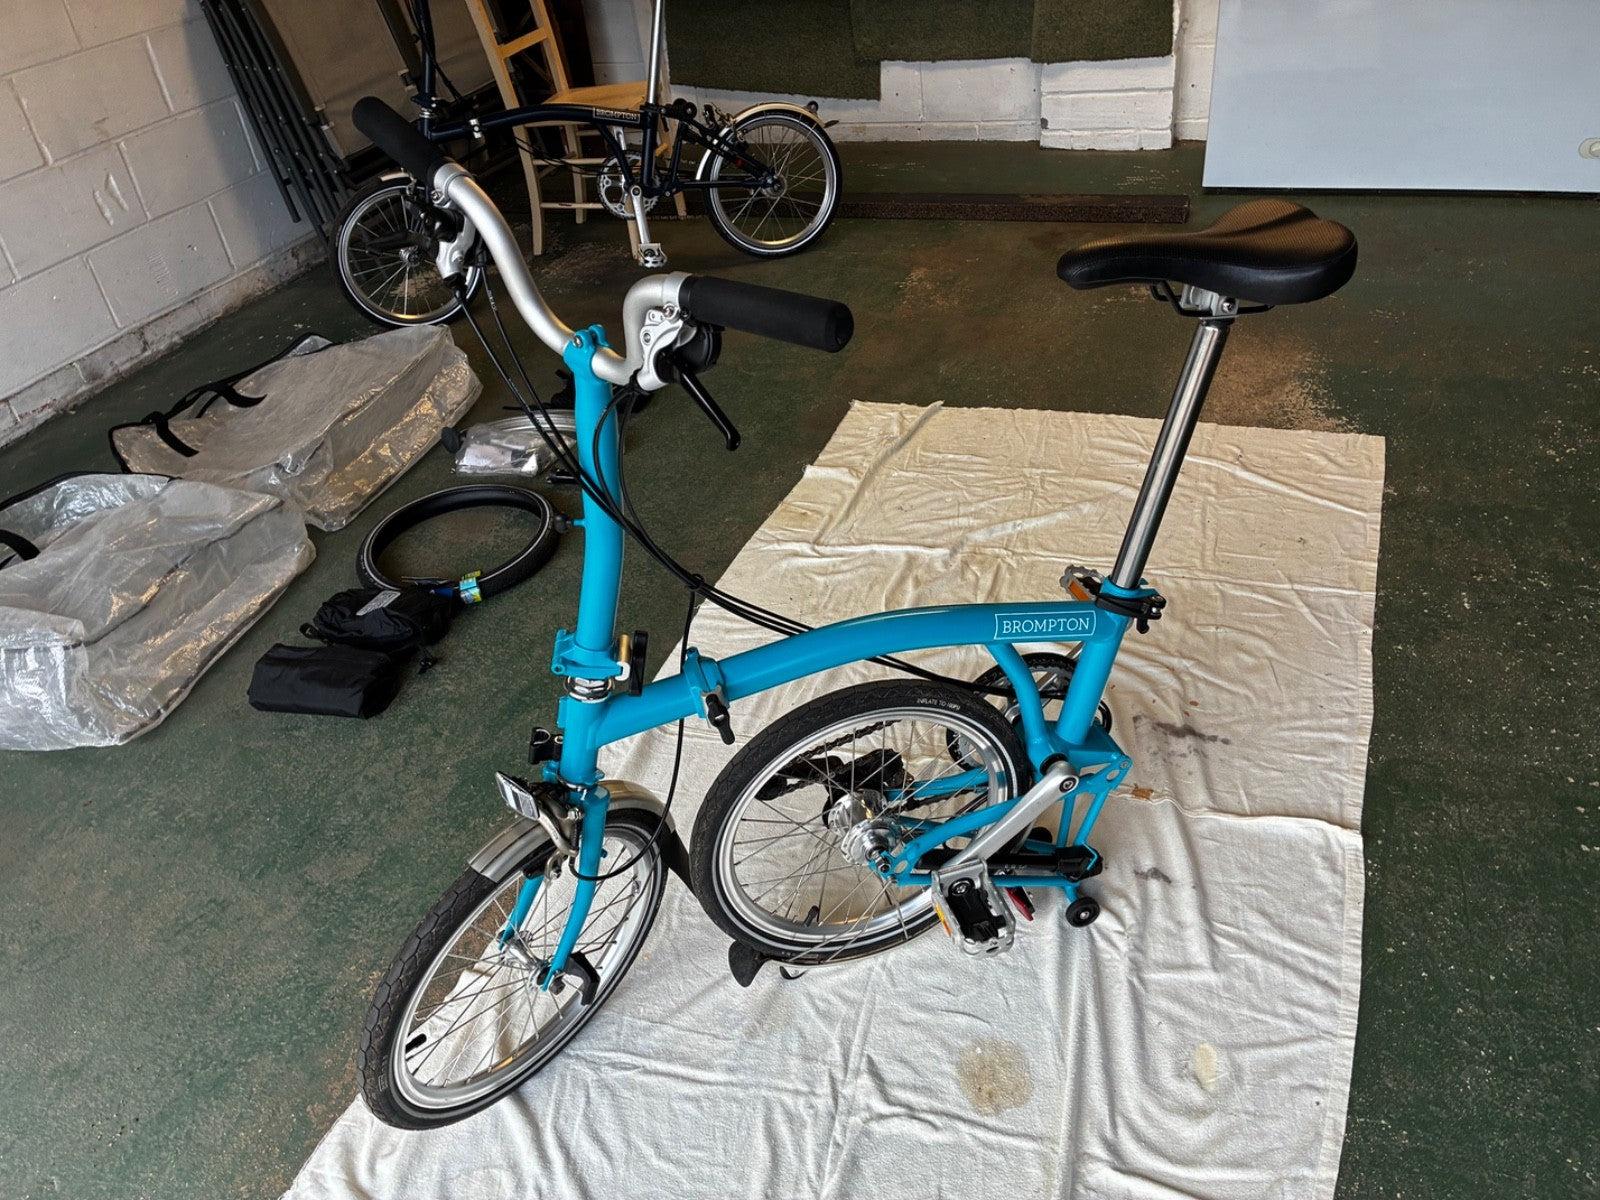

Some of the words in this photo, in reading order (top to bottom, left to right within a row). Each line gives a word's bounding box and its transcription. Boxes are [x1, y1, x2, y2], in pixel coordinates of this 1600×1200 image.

[596, 108, 637, 120] BROMPTON
[1002, 617, 1090, 634] BROMPTON
[916, 697, 938, 706] INFLATE
